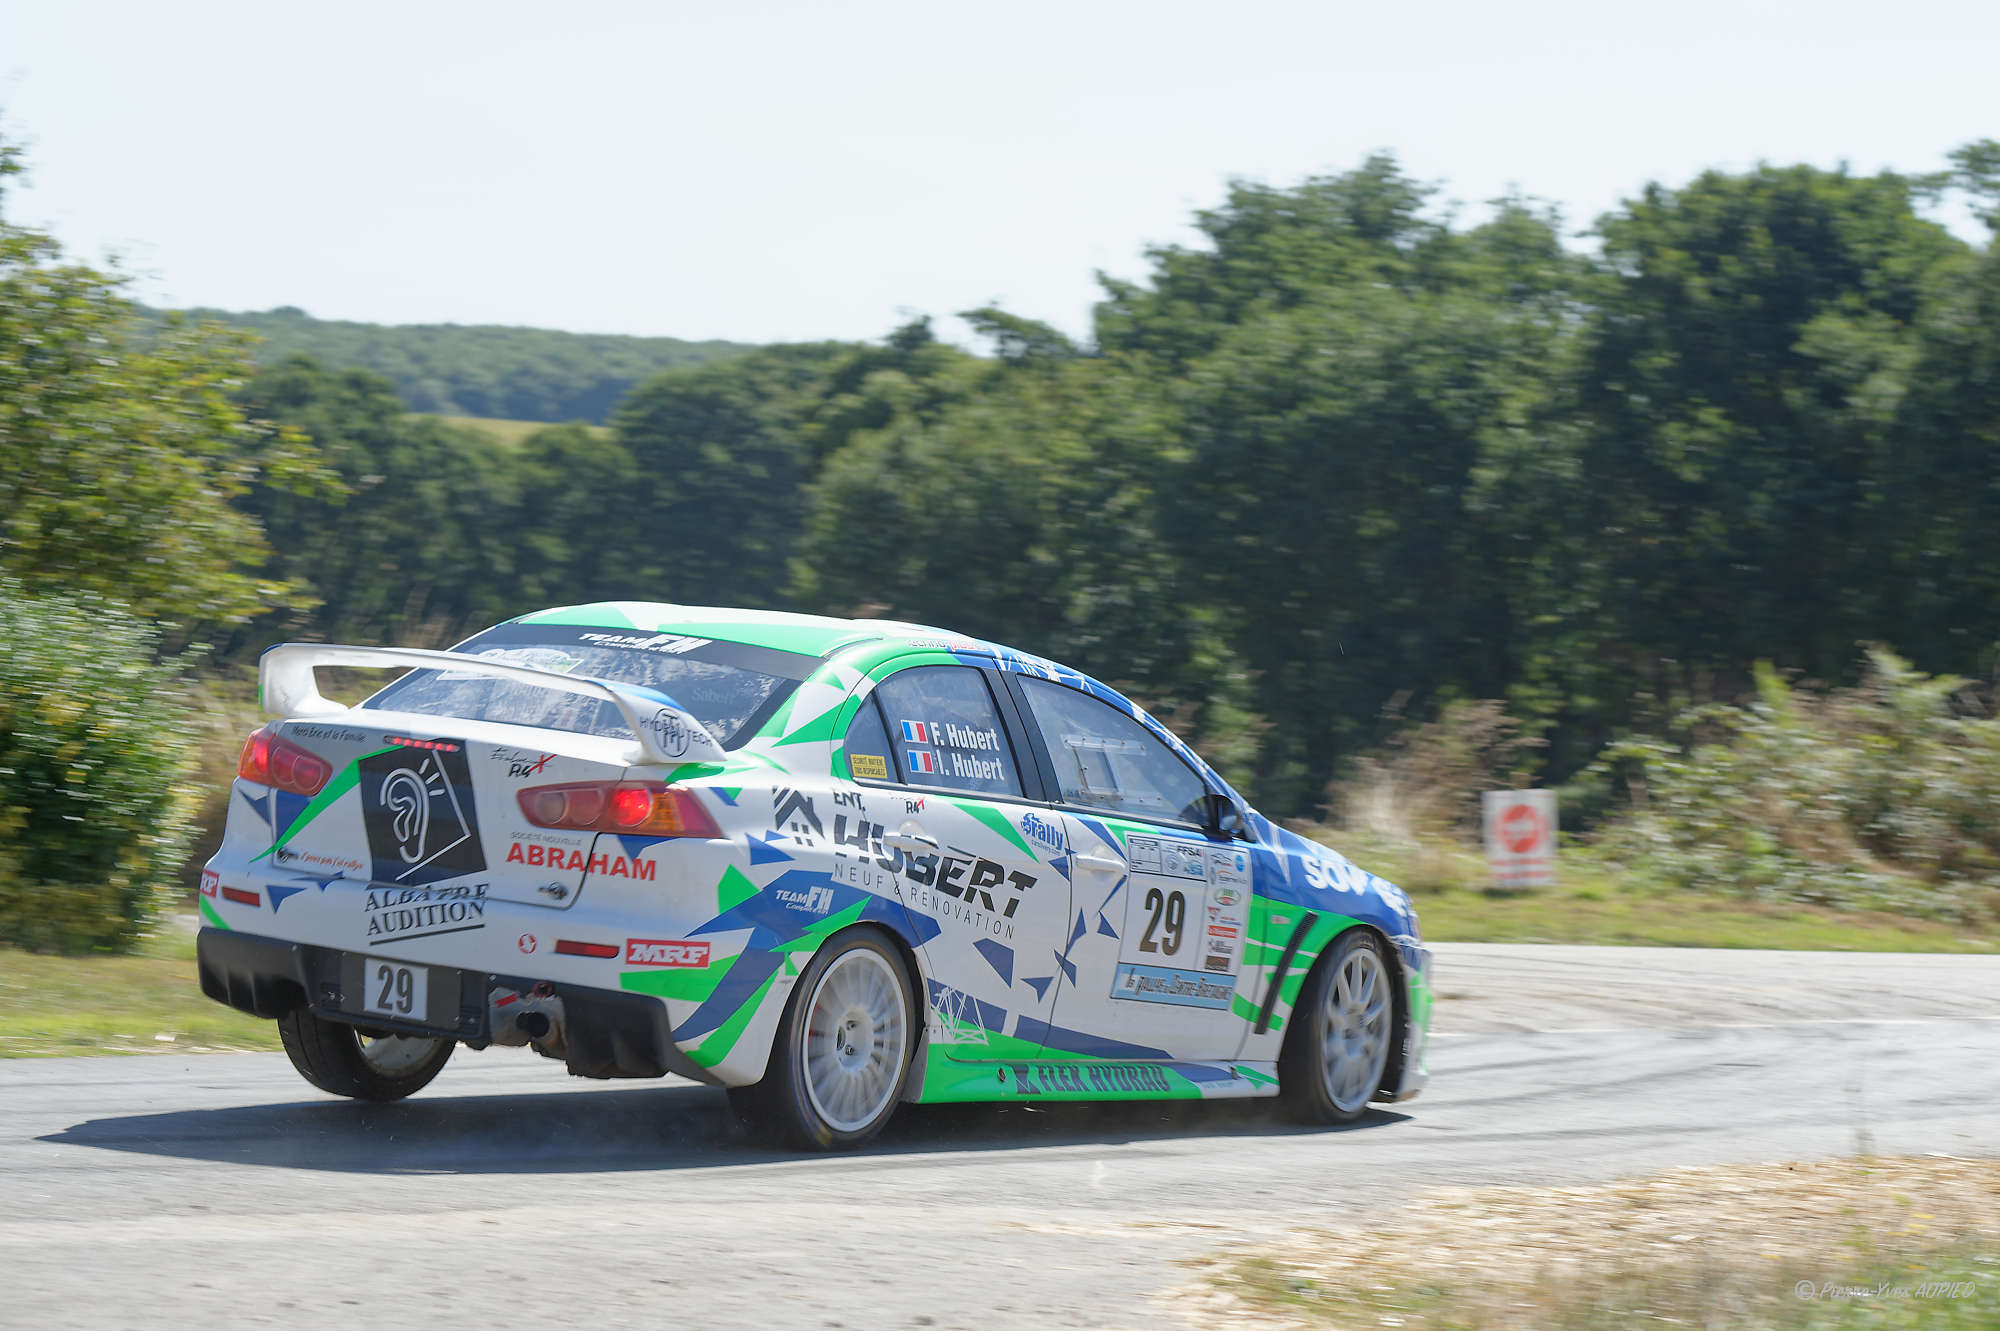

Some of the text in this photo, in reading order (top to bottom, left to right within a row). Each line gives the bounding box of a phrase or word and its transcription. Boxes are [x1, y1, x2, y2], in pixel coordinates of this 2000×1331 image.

[579, 633, 647, 646] TEAM
[930, 722, 1000, 751] F. Hubert
[952, 752, 1005, 780] Hubert
[833, 791, 866, 812] ENT.
[506, 842, 657, 882] ABRAHAM
[833, 814, 1039, 919] HUBERT
[776, 886, 834, 914] TEAM FH
[834, 863, 884, 890] NEUF
[910, 886, 1015, 941] RENOVATION
[367, 900, 488, 936] AUDITION
[1139, 887, 1185, 956] 29
[629, 944, 708, 964] MRF
[377, 964, 414, 1014] 29
[1037, 1063, 1090, 1092] FLEX
